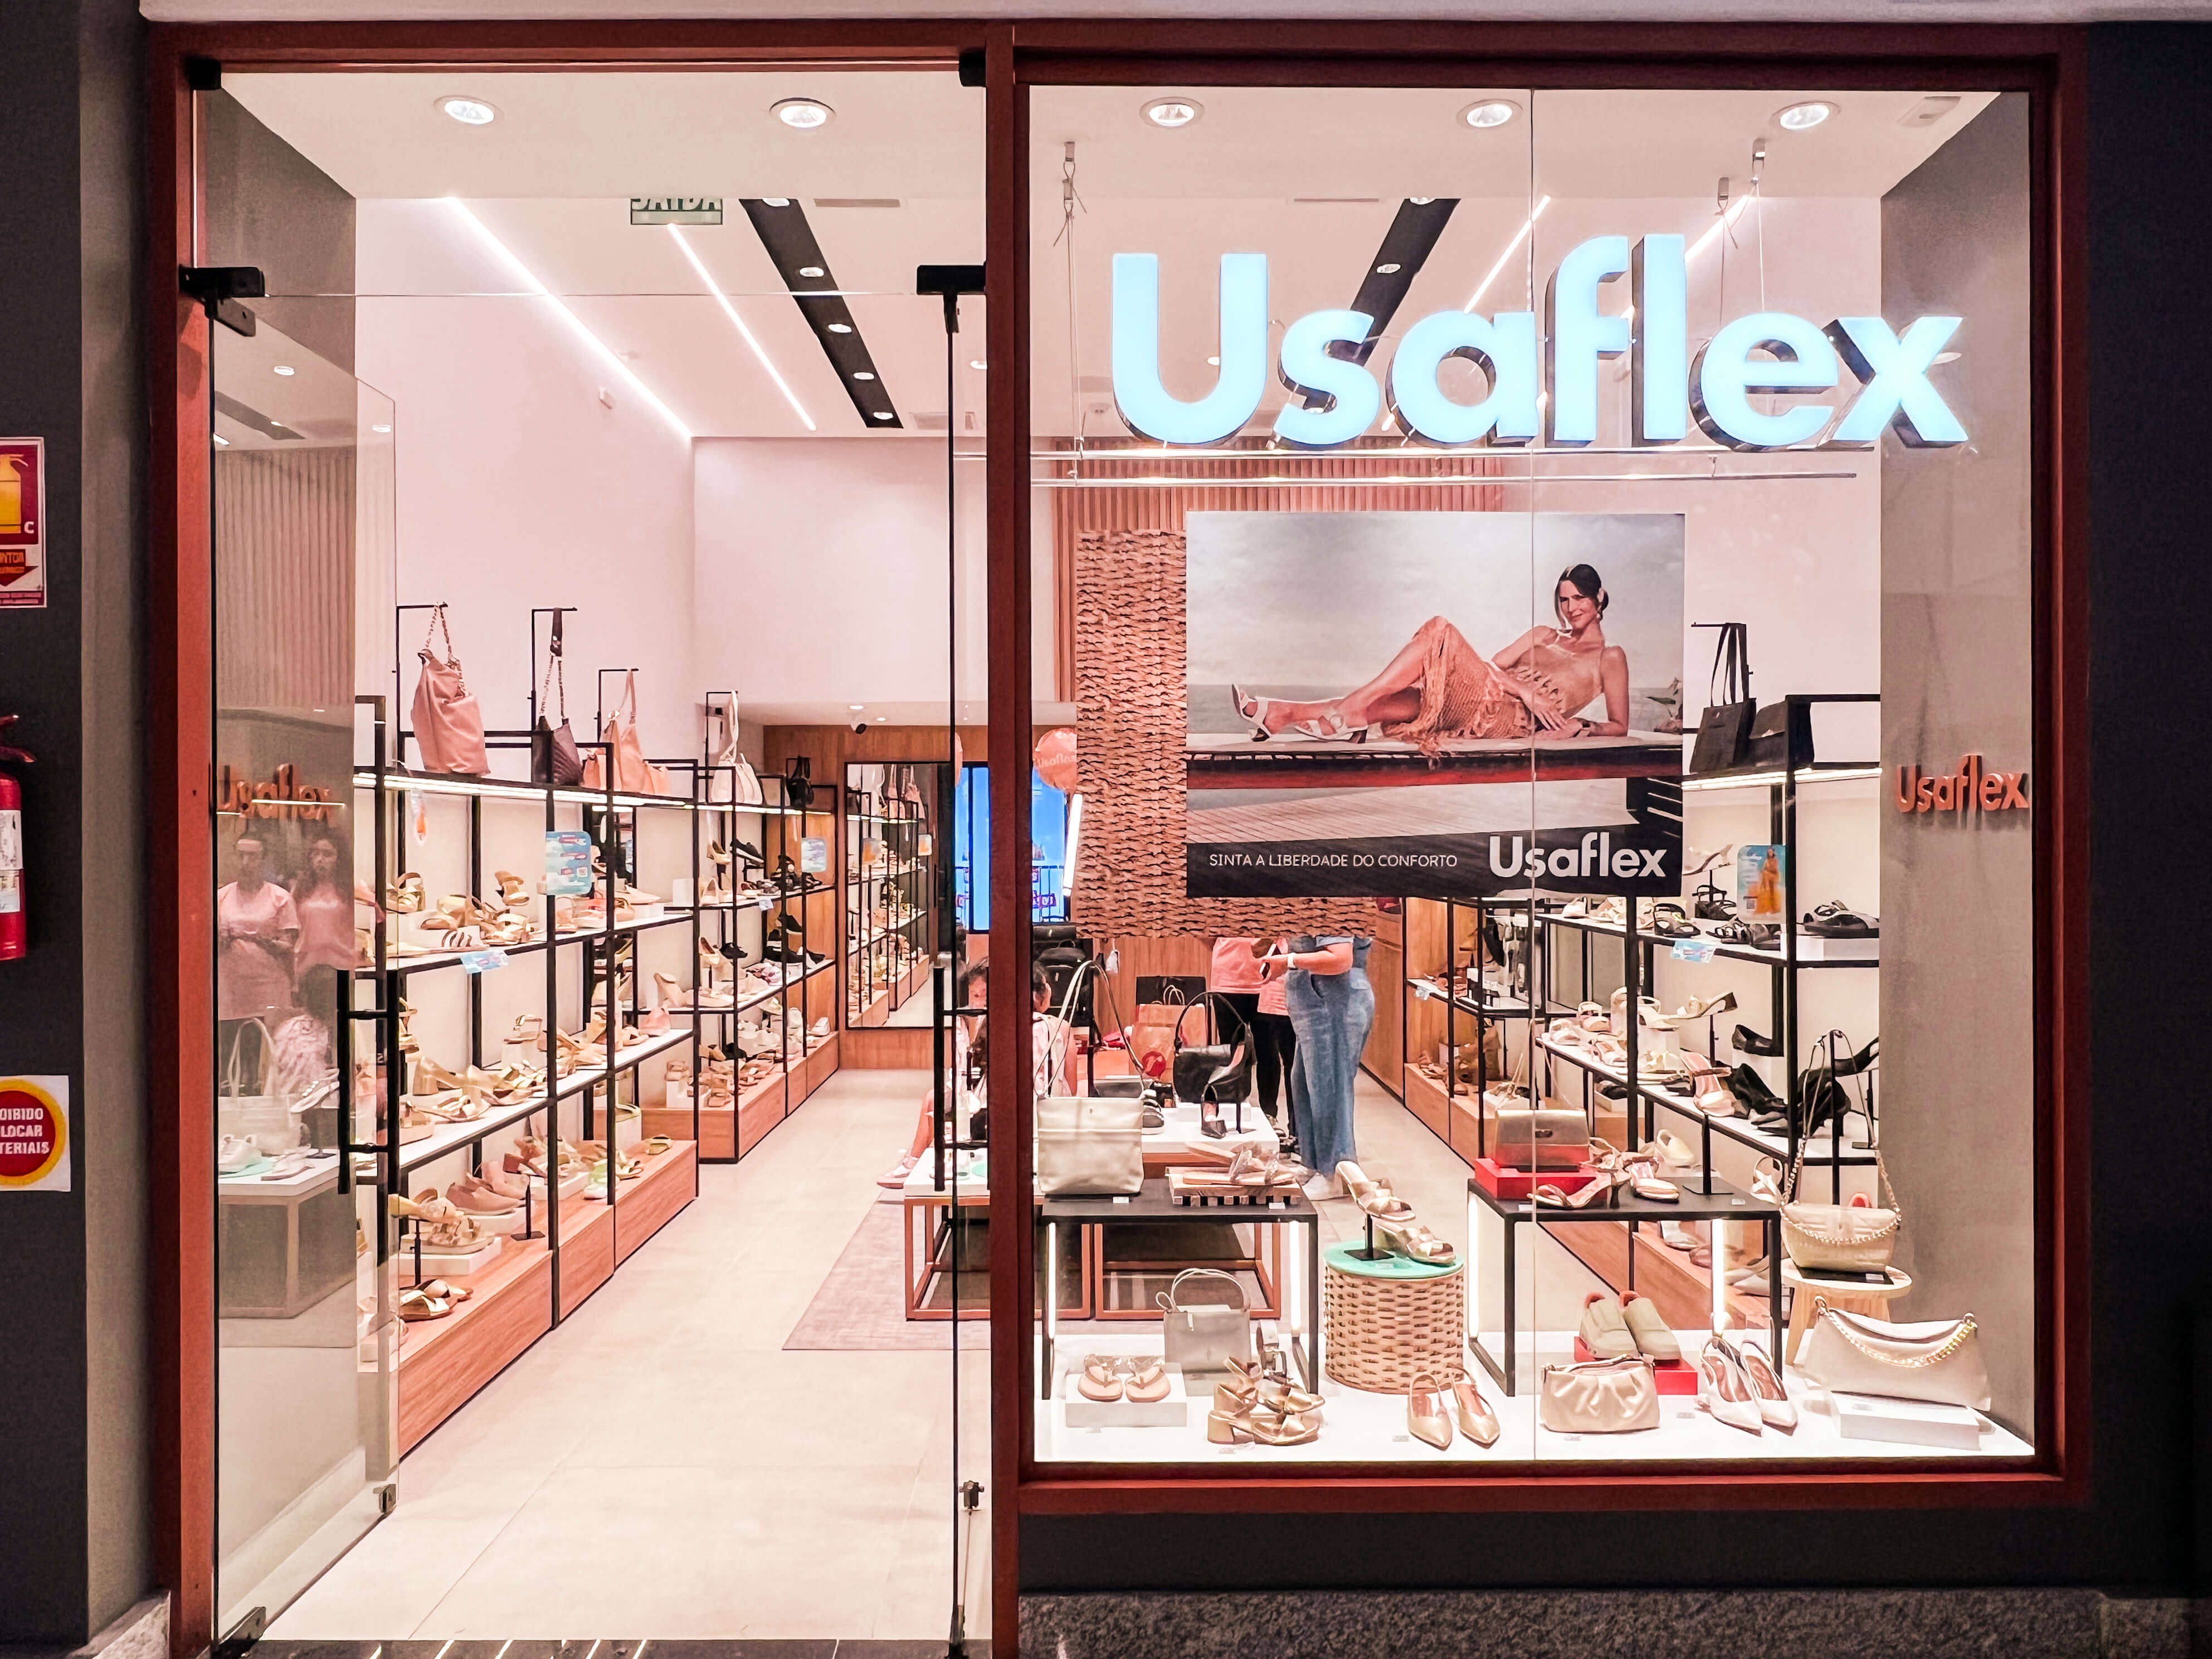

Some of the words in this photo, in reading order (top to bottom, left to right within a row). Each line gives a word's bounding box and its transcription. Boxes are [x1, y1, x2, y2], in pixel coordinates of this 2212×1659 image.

[1112, 233, 1968, 448] Usaflex
[24, 521, 35, 534] C
[1897, 754, 2030, 813] Usaflex
[1209, 854, 1252, 867] SINTA
[1256, 854, 1265, 866] A
[1269, 854, 1348, 867] LIBERDADE
[1353, 854, 1374, 867] DO
[1378, 854, 1458, 867] CONFORTO
[1489, 832, 1667, 878] Usaflex
